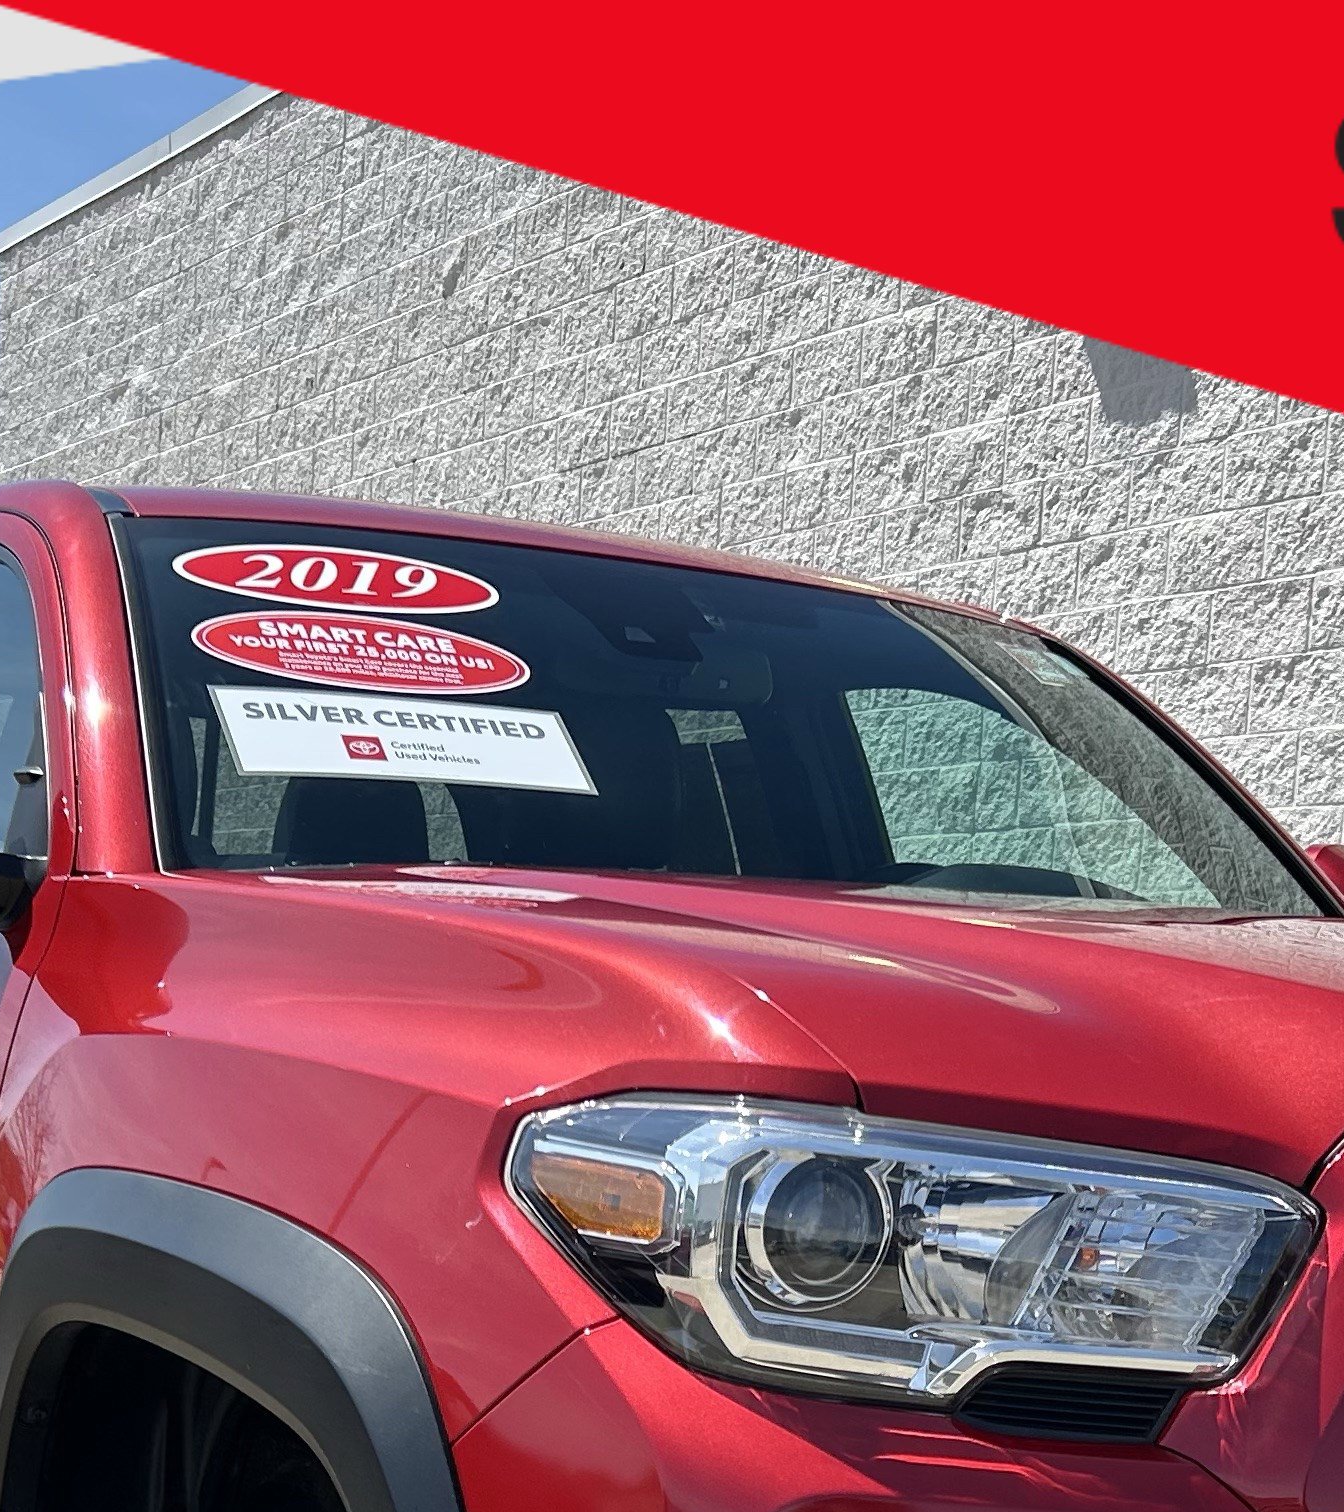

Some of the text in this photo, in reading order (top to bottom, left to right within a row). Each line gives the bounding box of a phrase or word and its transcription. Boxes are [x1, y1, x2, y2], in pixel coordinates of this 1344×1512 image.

[234, 553, 439, 599] 2019
[228, 633, 292, 651] YOUR
[294, 637, 350, 655] FIRST
[424, 652, 458, 667] ON
[459, 655, 495, 671] US!
[258, 620, 457, 655] SMART CARE
[242, 701, 546, 740] SILVER CERTIFIED
[390, 741, 446, 753] Certified
[394, 750, 481, 765] Used Vehicles
